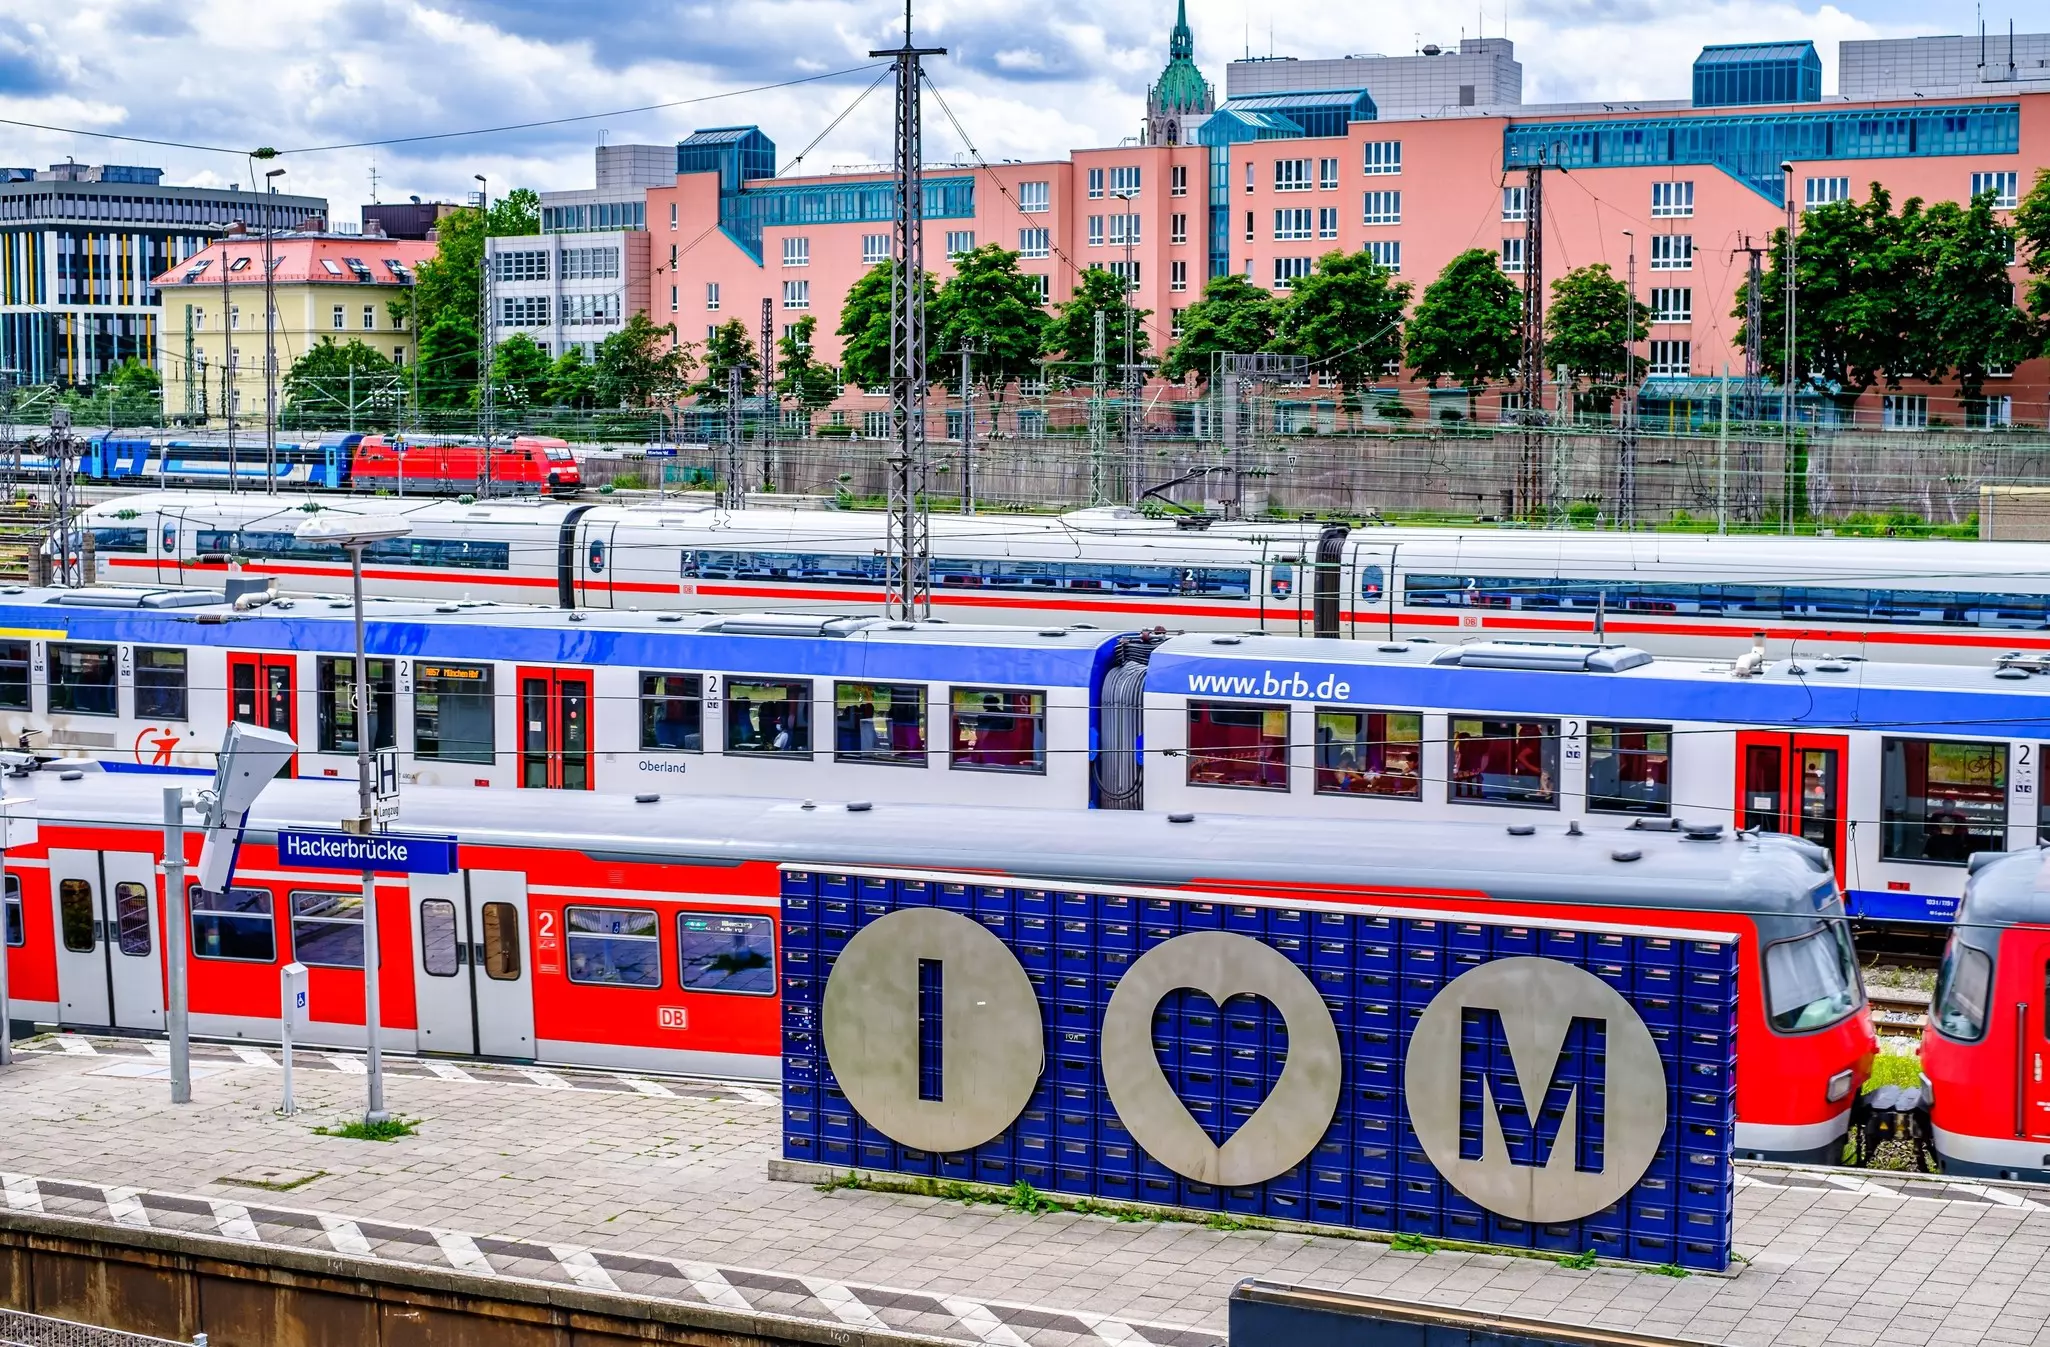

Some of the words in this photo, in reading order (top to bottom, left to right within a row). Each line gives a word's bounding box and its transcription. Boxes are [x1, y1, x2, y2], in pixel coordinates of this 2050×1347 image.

[232, 533, 238, 543] 2
[462, 542, 469, 553] 2
[684, 551, 692, 563] 2
[1186, 569, 1193, 581] 2
[1467, 577, 1476, 590] 2
[1465, 617, 1477, 626] DB
[35, 642, 41, 658] 1
[122, 646, 129, 662] 2
[400, 660, 408, 677] 2
[708, 675, 717, 693] 2
[1188, 670, 1350, 700] www.brb.de
[1568, 720, 1579, 740] 2
[2018, 744, 2030, 765] 2
[379, 753, 397, 795] H
[639, 760, 686, 774] Oberland
[379, 806, 399, 818] Langzug
[287, 835, 408, 861] Hackerbrücke
[538, 911, 554, 937] 2
[660, 1008, 685, 1027] DB
[918, 957, 943, 1103] I
[1459, 1006, 1607, 1175] M
